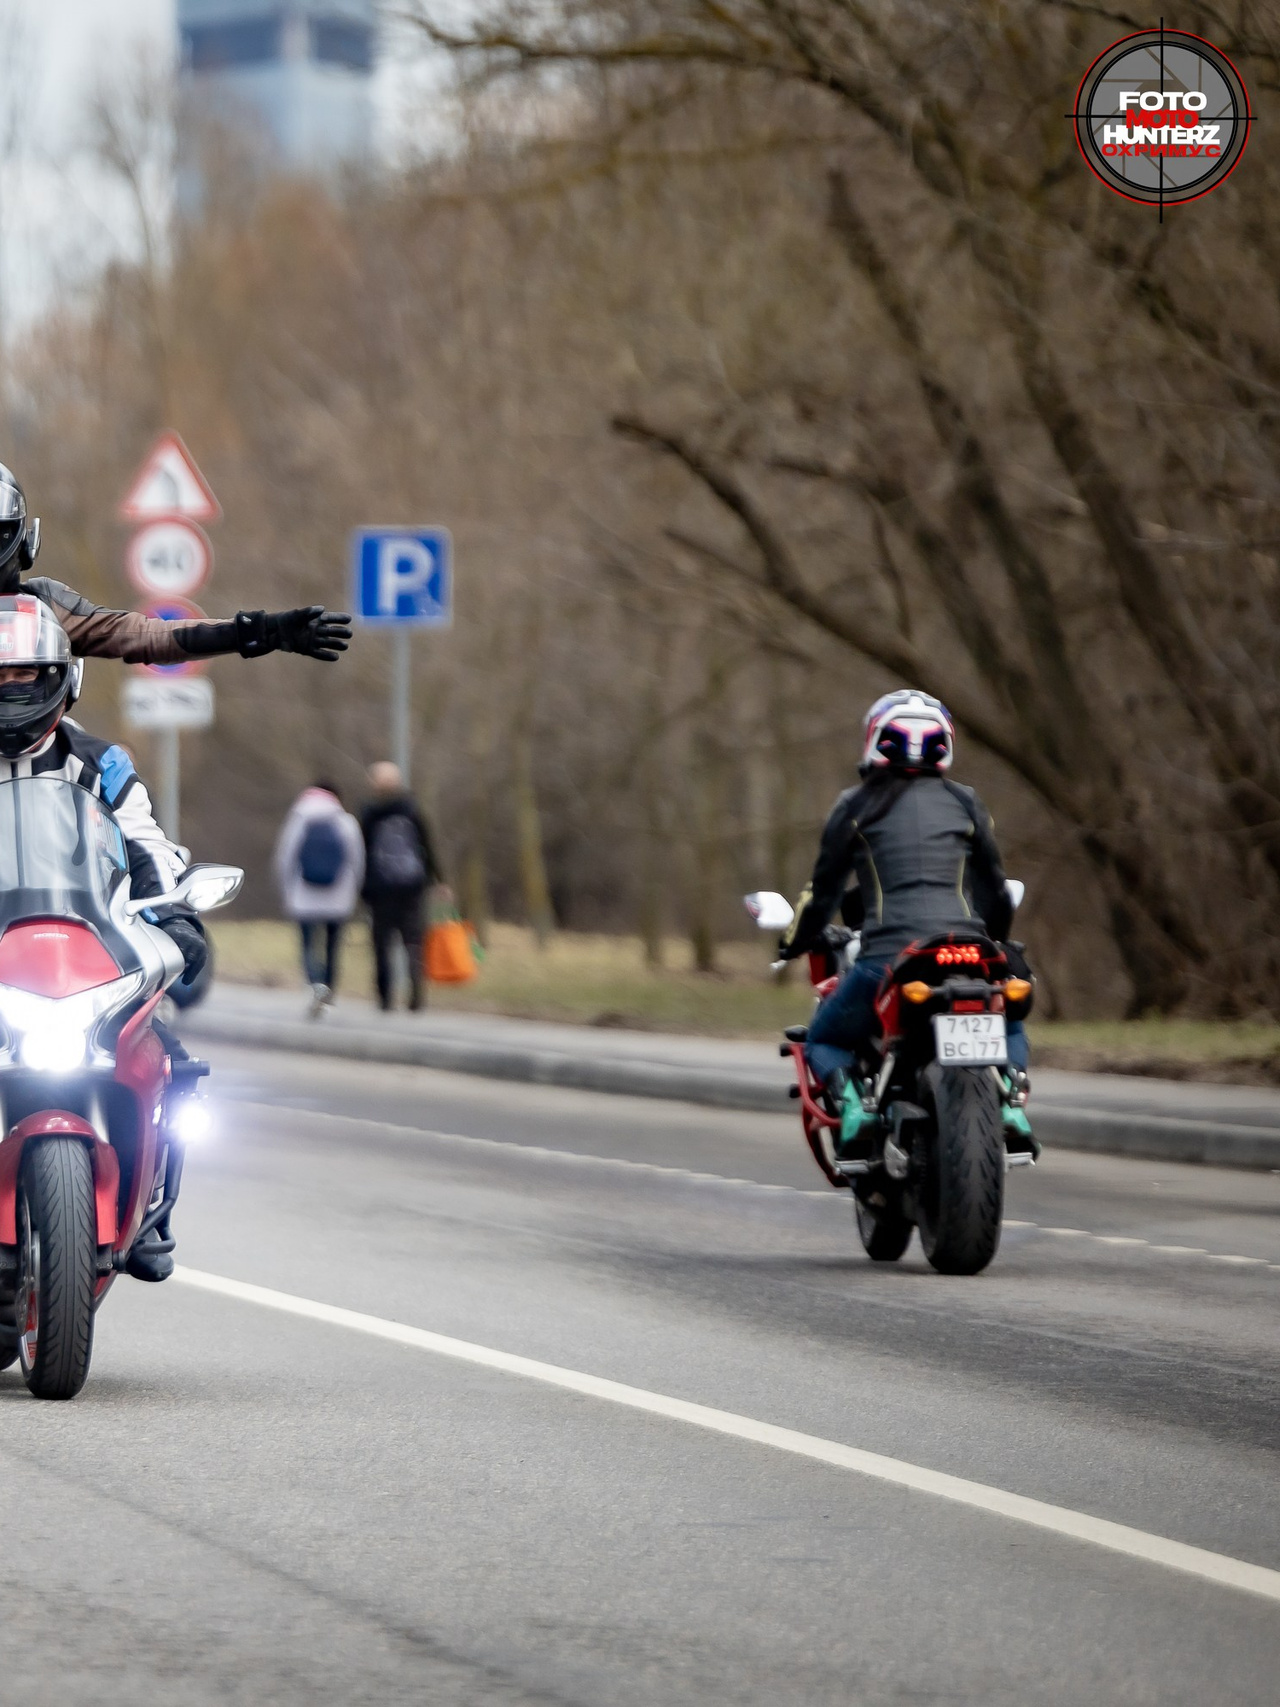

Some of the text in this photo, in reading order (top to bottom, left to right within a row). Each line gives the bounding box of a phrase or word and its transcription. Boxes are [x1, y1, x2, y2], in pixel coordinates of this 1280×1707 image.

[376, 537, 433, 613] P
[947, 1017, 993, 1033] 7127
[978, 1041, 1000, 1056] 77
